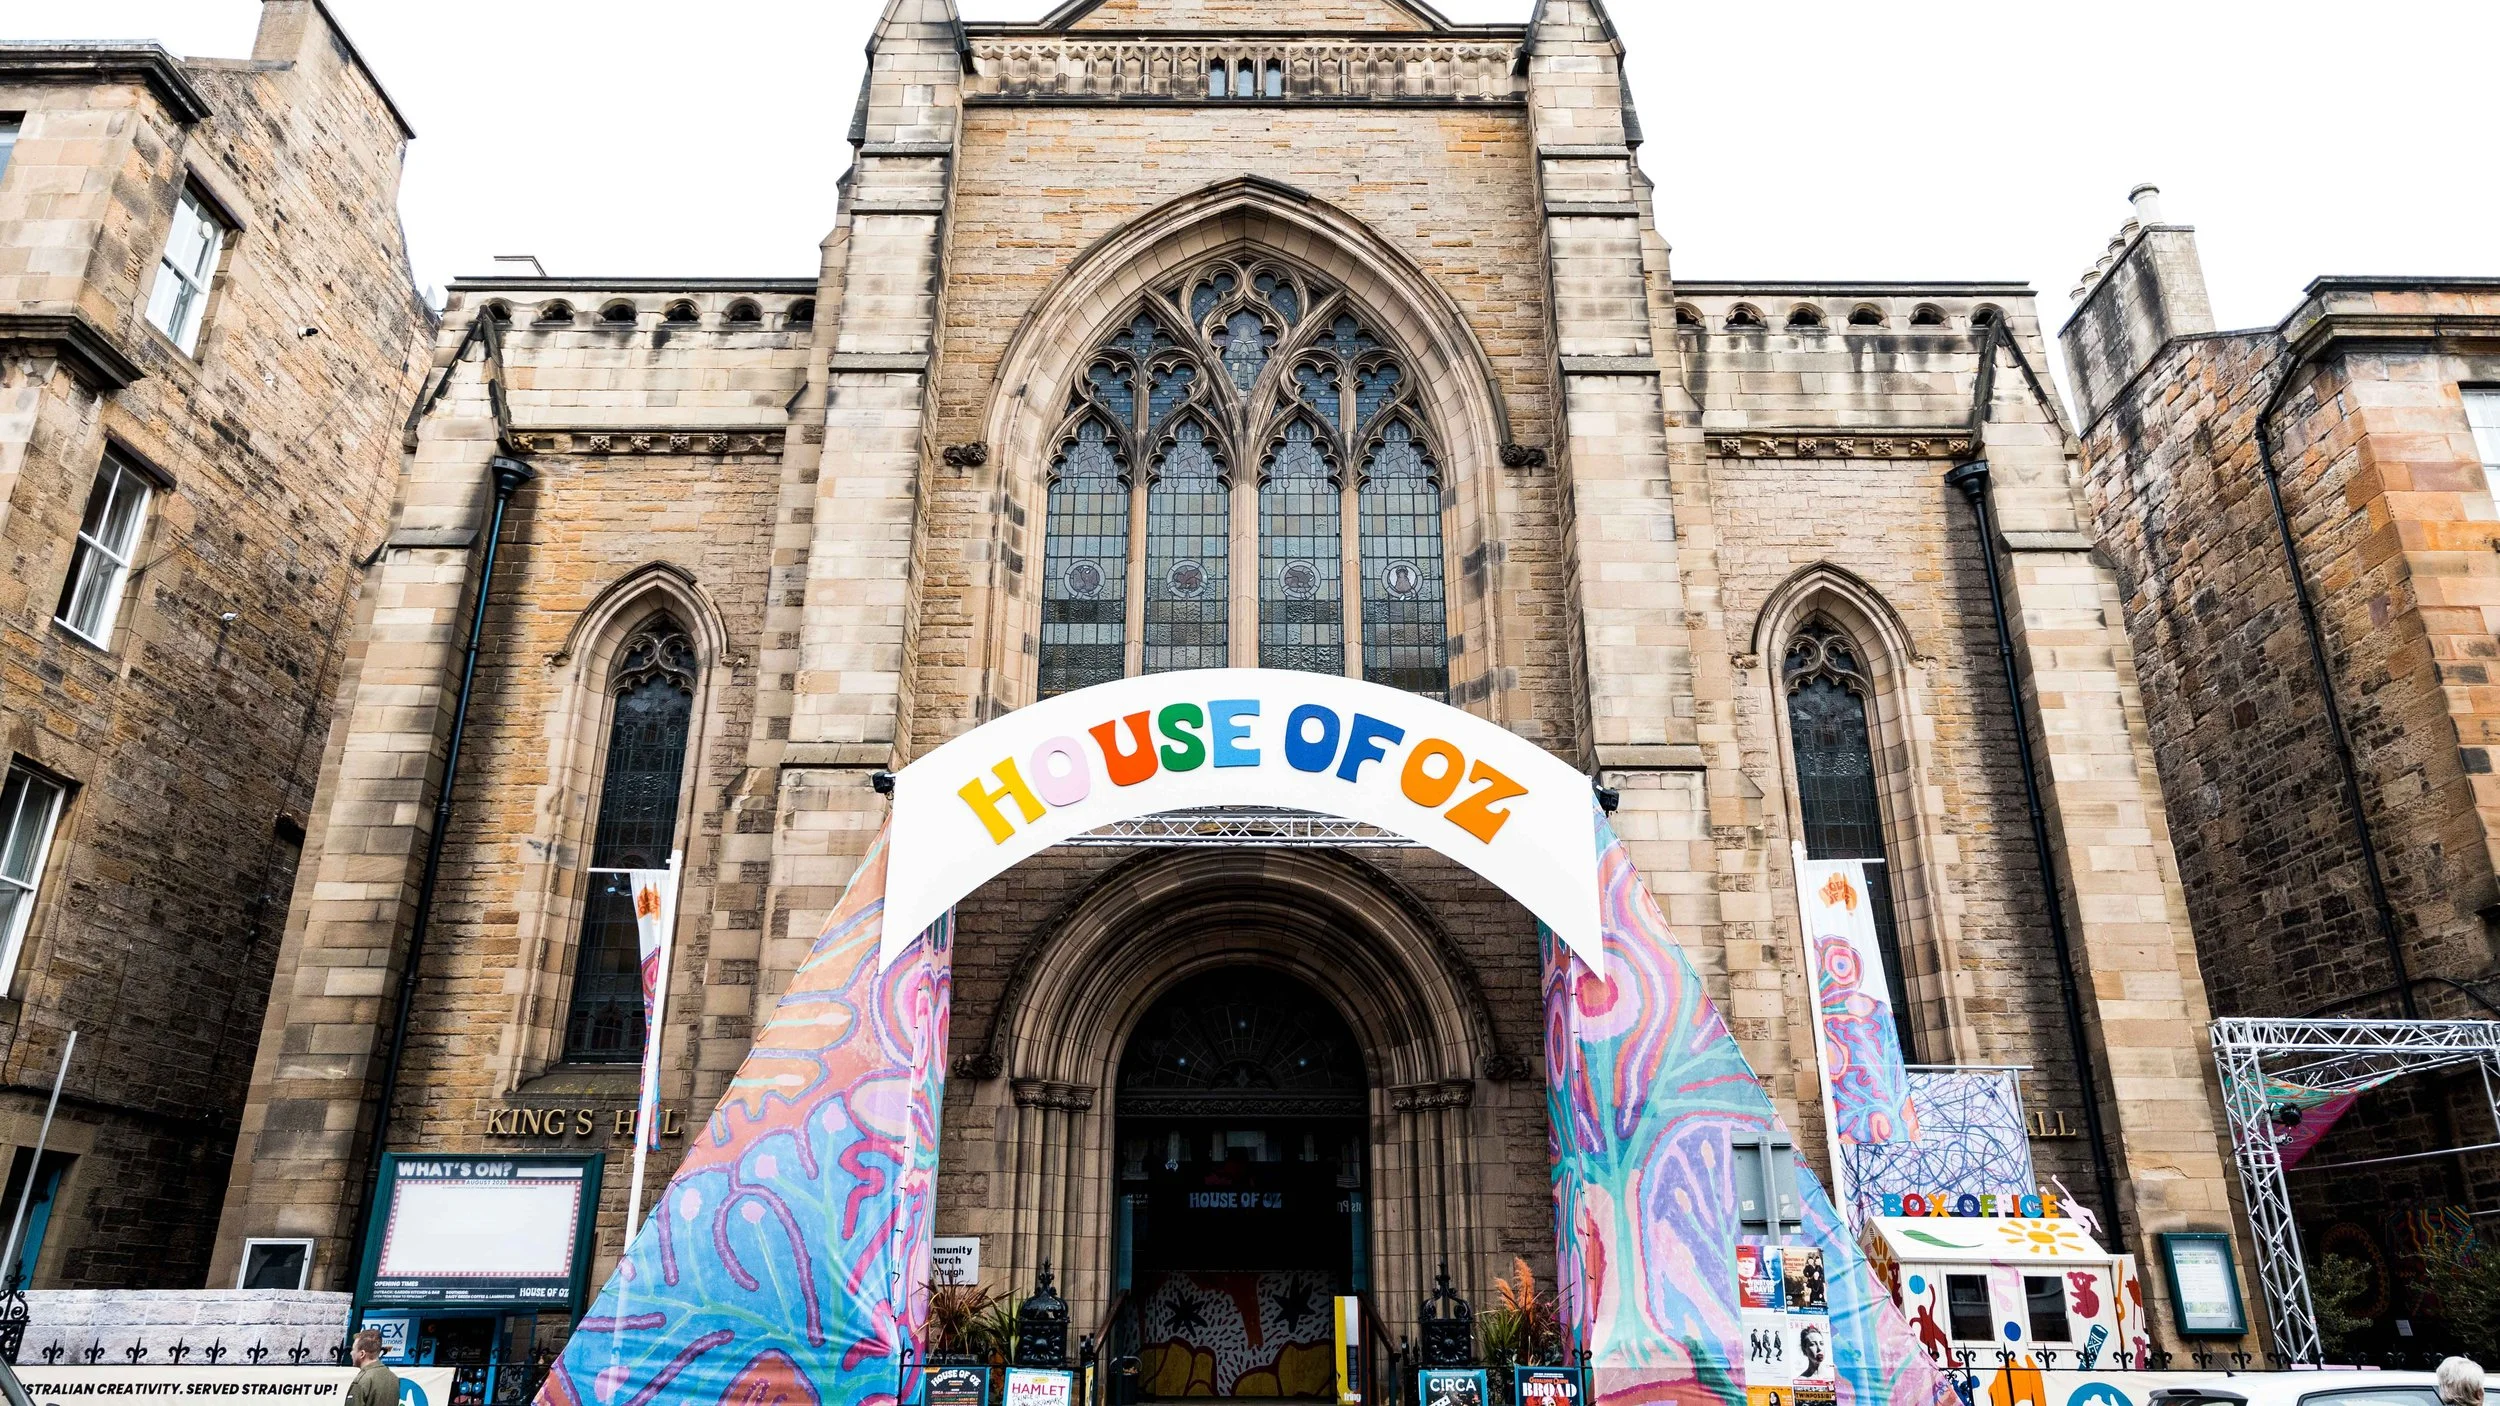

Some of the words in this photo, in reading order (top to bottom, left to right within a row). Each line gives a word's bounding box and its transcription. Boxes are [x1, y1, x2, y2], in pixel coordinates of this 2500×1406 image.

[957, 699, 1260, 845] HOUSE
[1285, 703, 1406, 783] OF
[1400, 737, 1530, 844] OZ
[612, 1108, 687, 1136] HL
[398, 1161, 471, 1177] WHAT'S
[475, 1161, 513, 1177] ON?
[1189, 1191, 1238, 1209] HOUSE
[1240, 1191, 1260, 1208] OF
[1264, 1192, 1282, 1208] OZ
[1881, 1193, 1950, 1218] BOX
[1956, 1193, 2060, 1218] OFFICE
[519, 1288, 546, 1297] HOUSE
[547, 1288, 558, 1297] OF
[558, 1288, 570, 1298] OZ
[930, 1370, 958, 1387] HOUSE
[958, 1370, 970, 1379] OF
[969, 1374, 981, 1387] OZ
[22, 1383, 95, 1394] STRALIAN
[97, 1383, 184, 1395] CREATIVITY.
[186, 1383, 240, 1395] SERVED
[242, 1383, 312, 1395] STRAIGHT
[313, 1383, 338, 1395] UP!
[1012, 1383, 1066, 1396] HAMLET
[1522, 1382, 1578, 1397] BROAD
